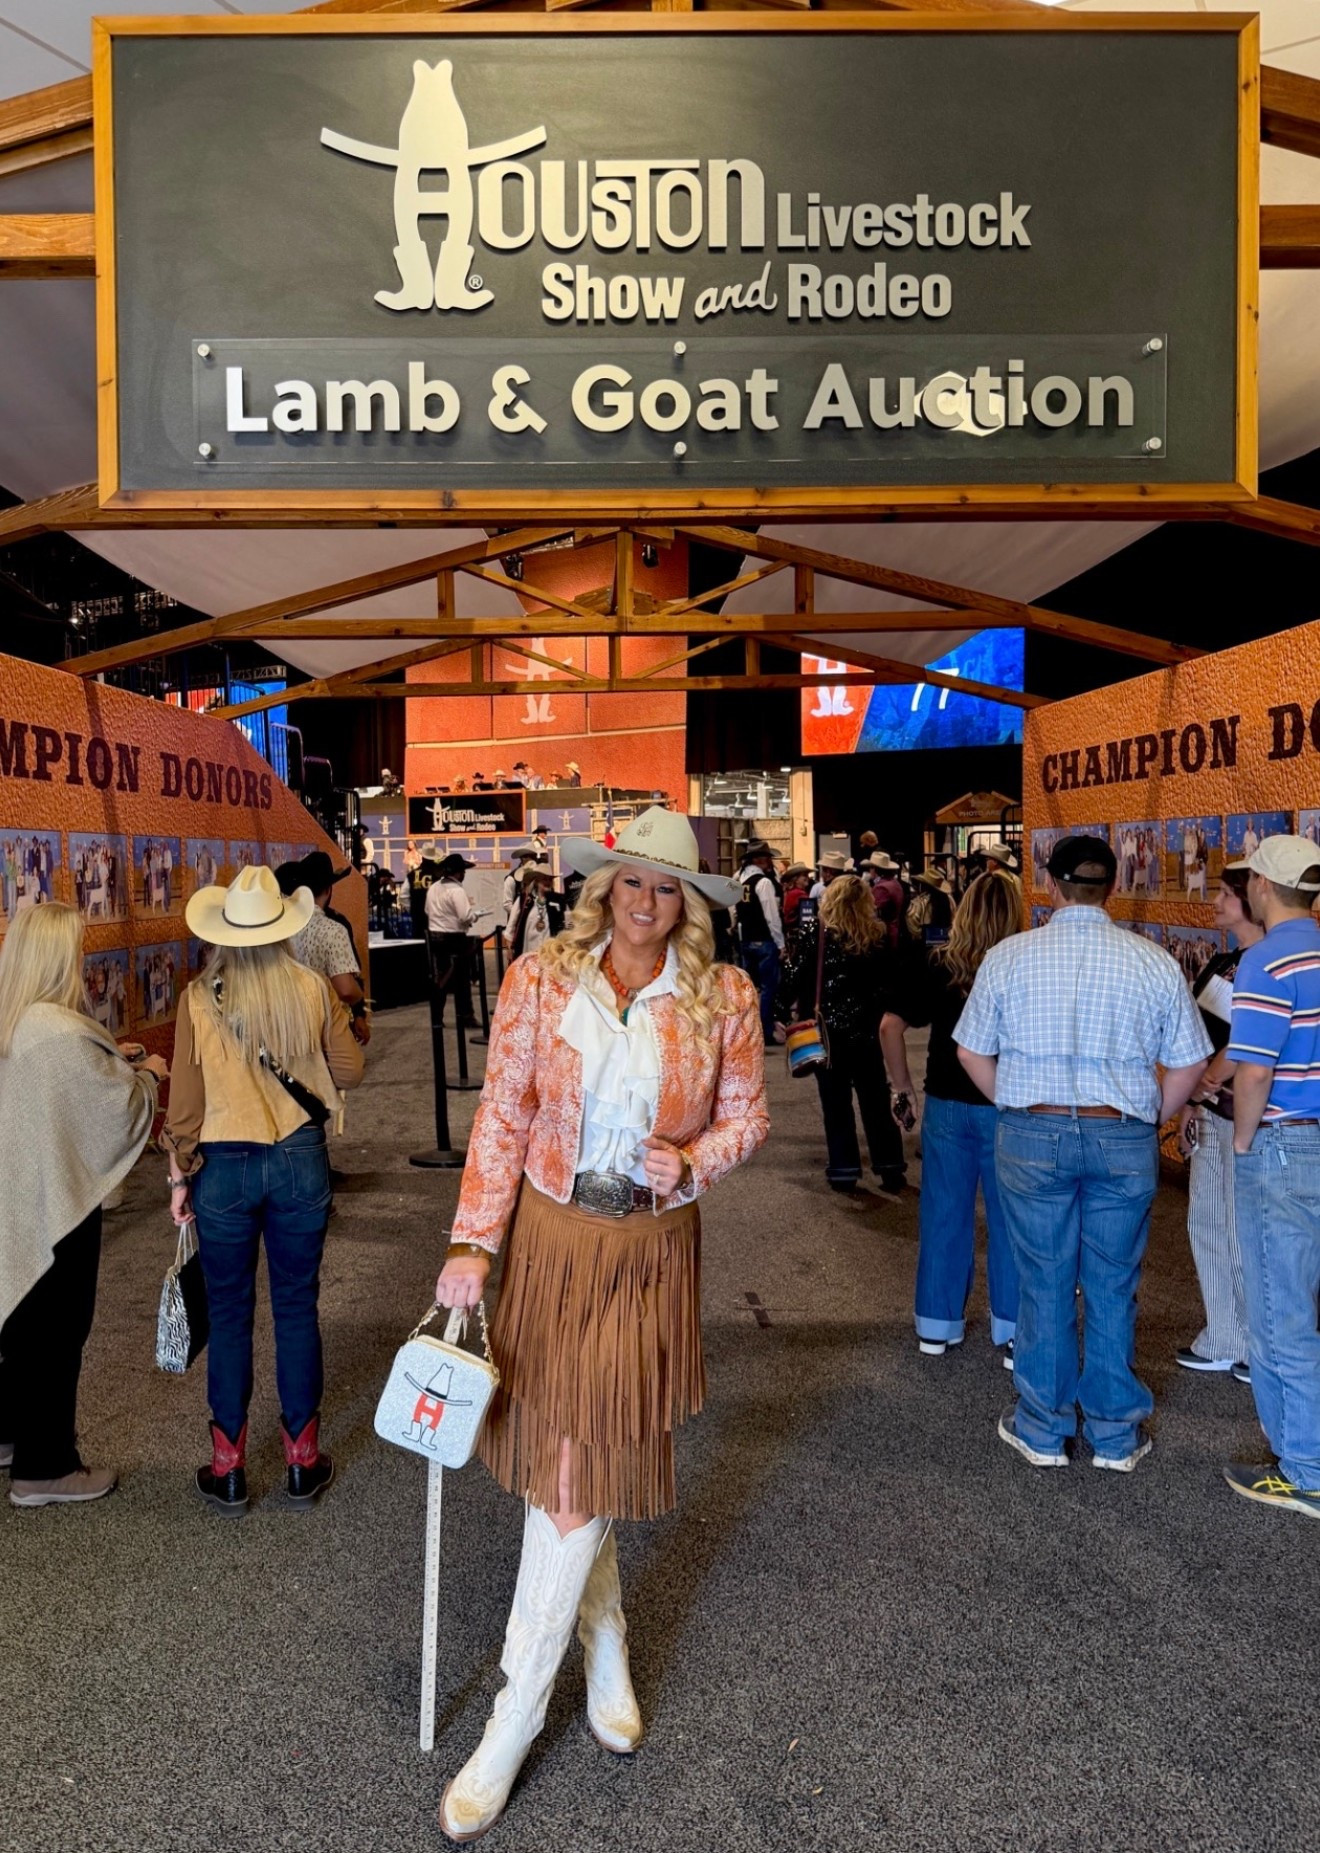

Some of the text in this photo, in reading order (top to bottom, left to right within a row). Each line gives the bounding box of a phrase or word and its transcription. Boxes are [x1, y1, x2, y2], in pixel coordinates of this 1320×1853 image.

[777, 191, 1032, 248] Livestock
[541, 260, 953, 320] Show and Rodeo
[225, 358, 1135, 434] Lamb & Goat Auction
[160, 751, 273, 811] DONORS
[1041, 714, 1240, 793] CHAMPION
